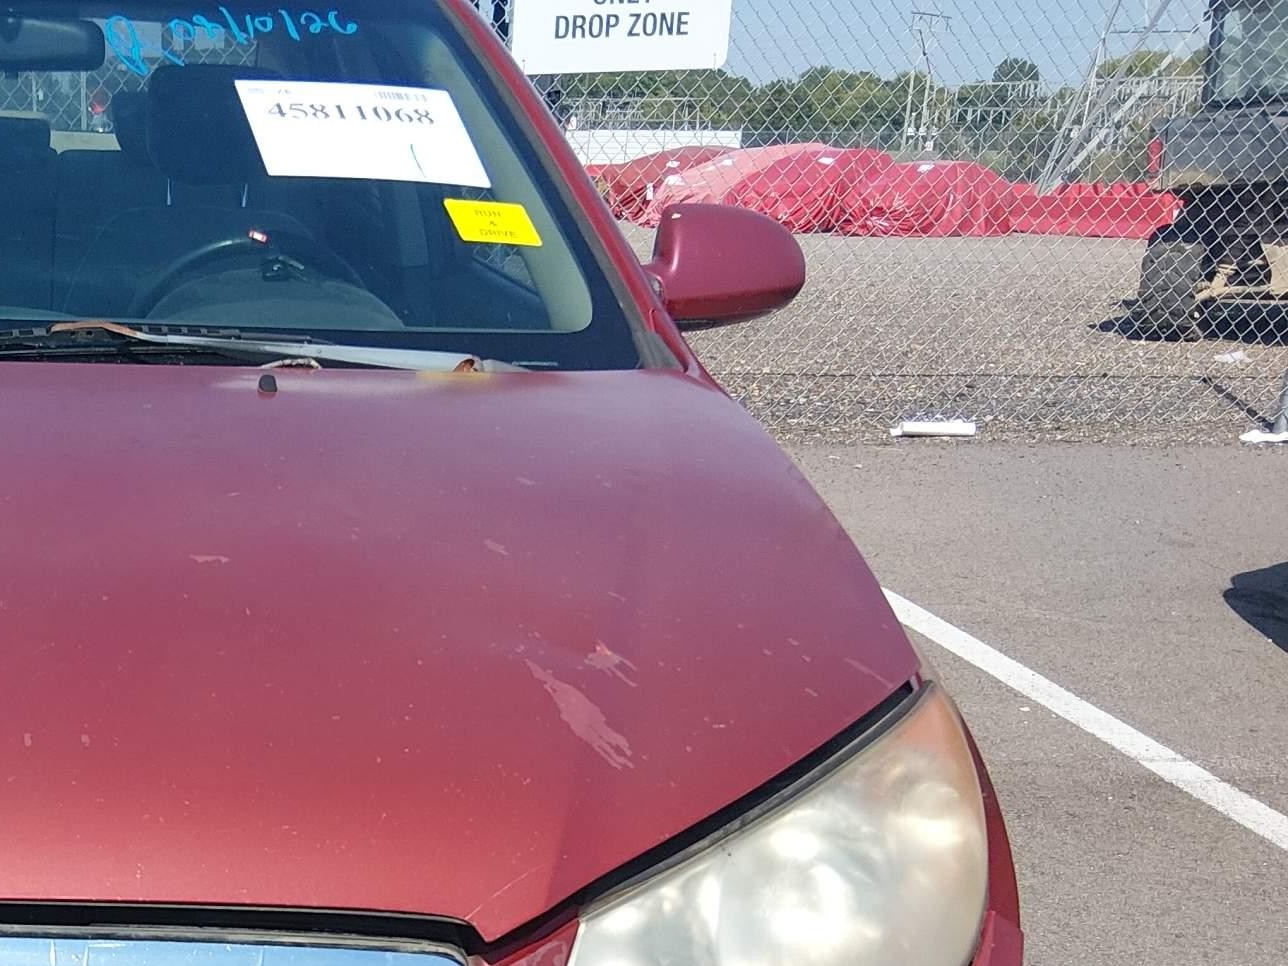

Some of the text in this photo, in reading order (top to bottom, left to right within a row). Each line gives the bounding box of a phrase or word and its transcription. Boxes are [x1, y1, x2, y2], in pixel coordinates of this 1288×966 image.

[554, 11, 691, 39] DROP ZONE
[268, 102, 435, 125] 45811068
